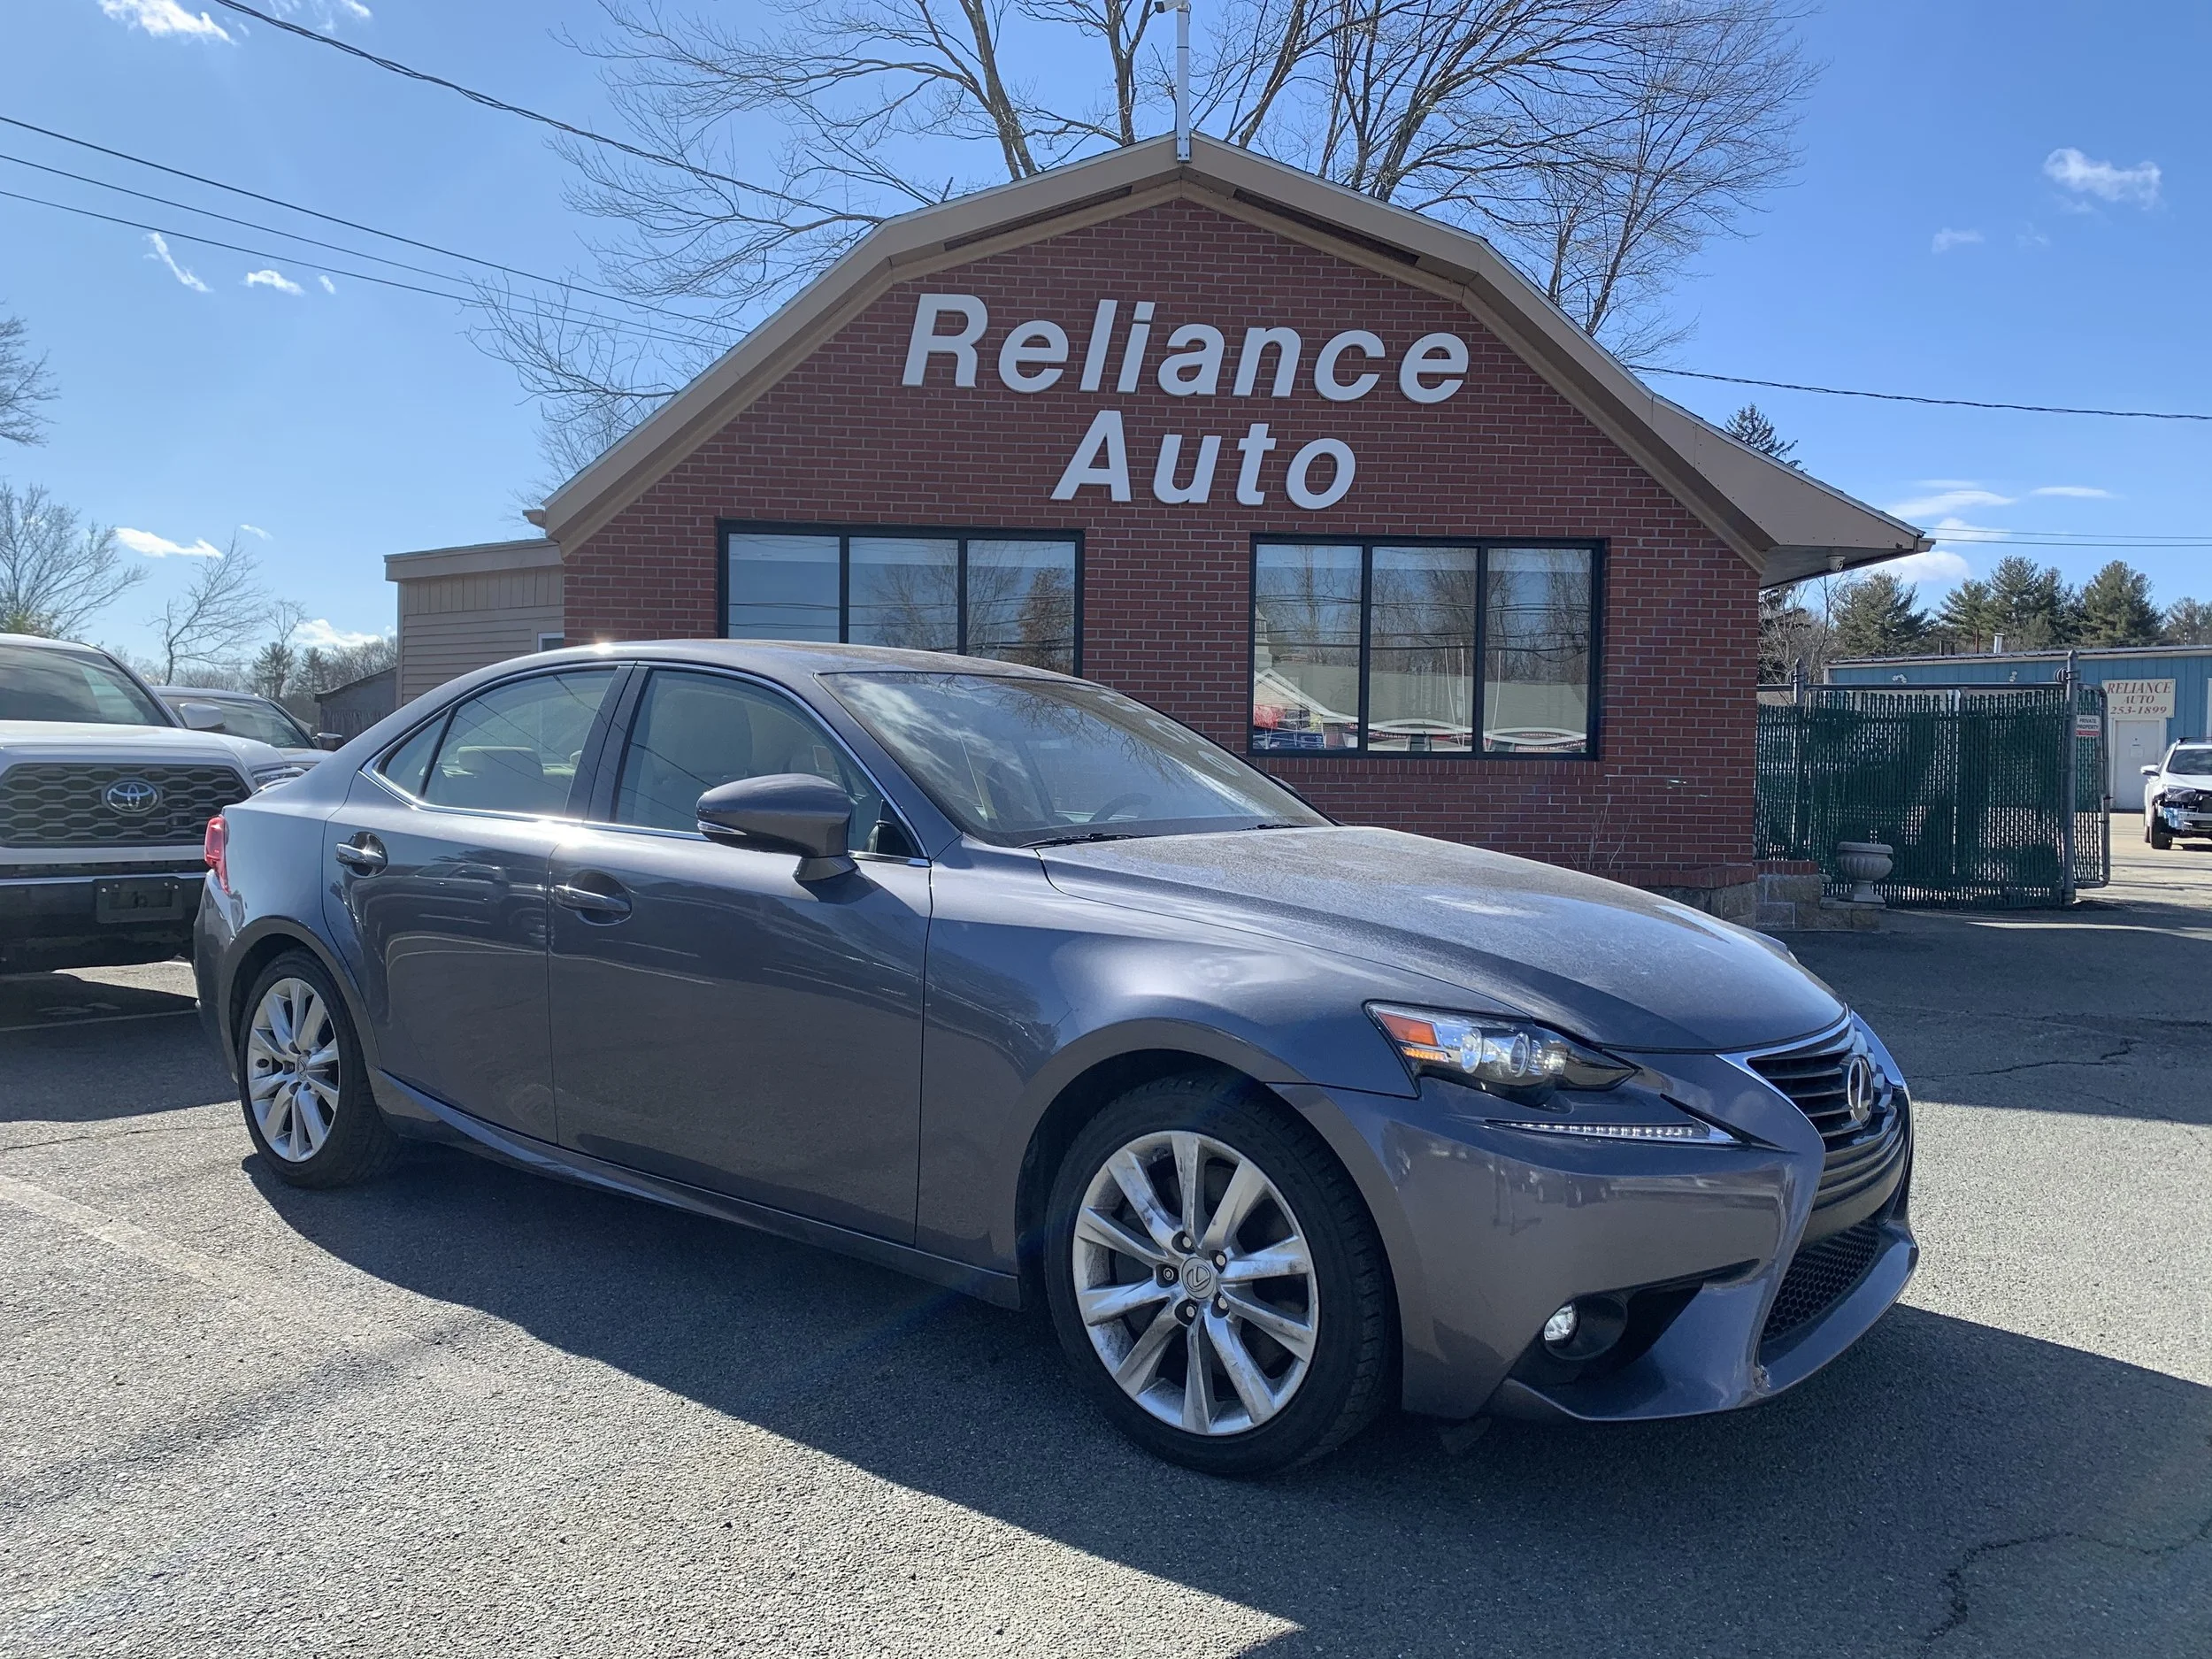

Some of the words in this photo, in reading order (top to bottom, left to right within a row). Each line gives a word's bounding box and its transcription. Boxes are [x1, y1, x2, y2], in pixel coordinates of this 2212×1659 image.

[901, 292, 1471, 404] Reliance
[1049, 409, 1356, 511] Auto
[2107, 681, 2173, 695] RELIANCE
[2124, 695, 2154, 704] AUTO
[2110, 706, 2167, 715] 253-1899
